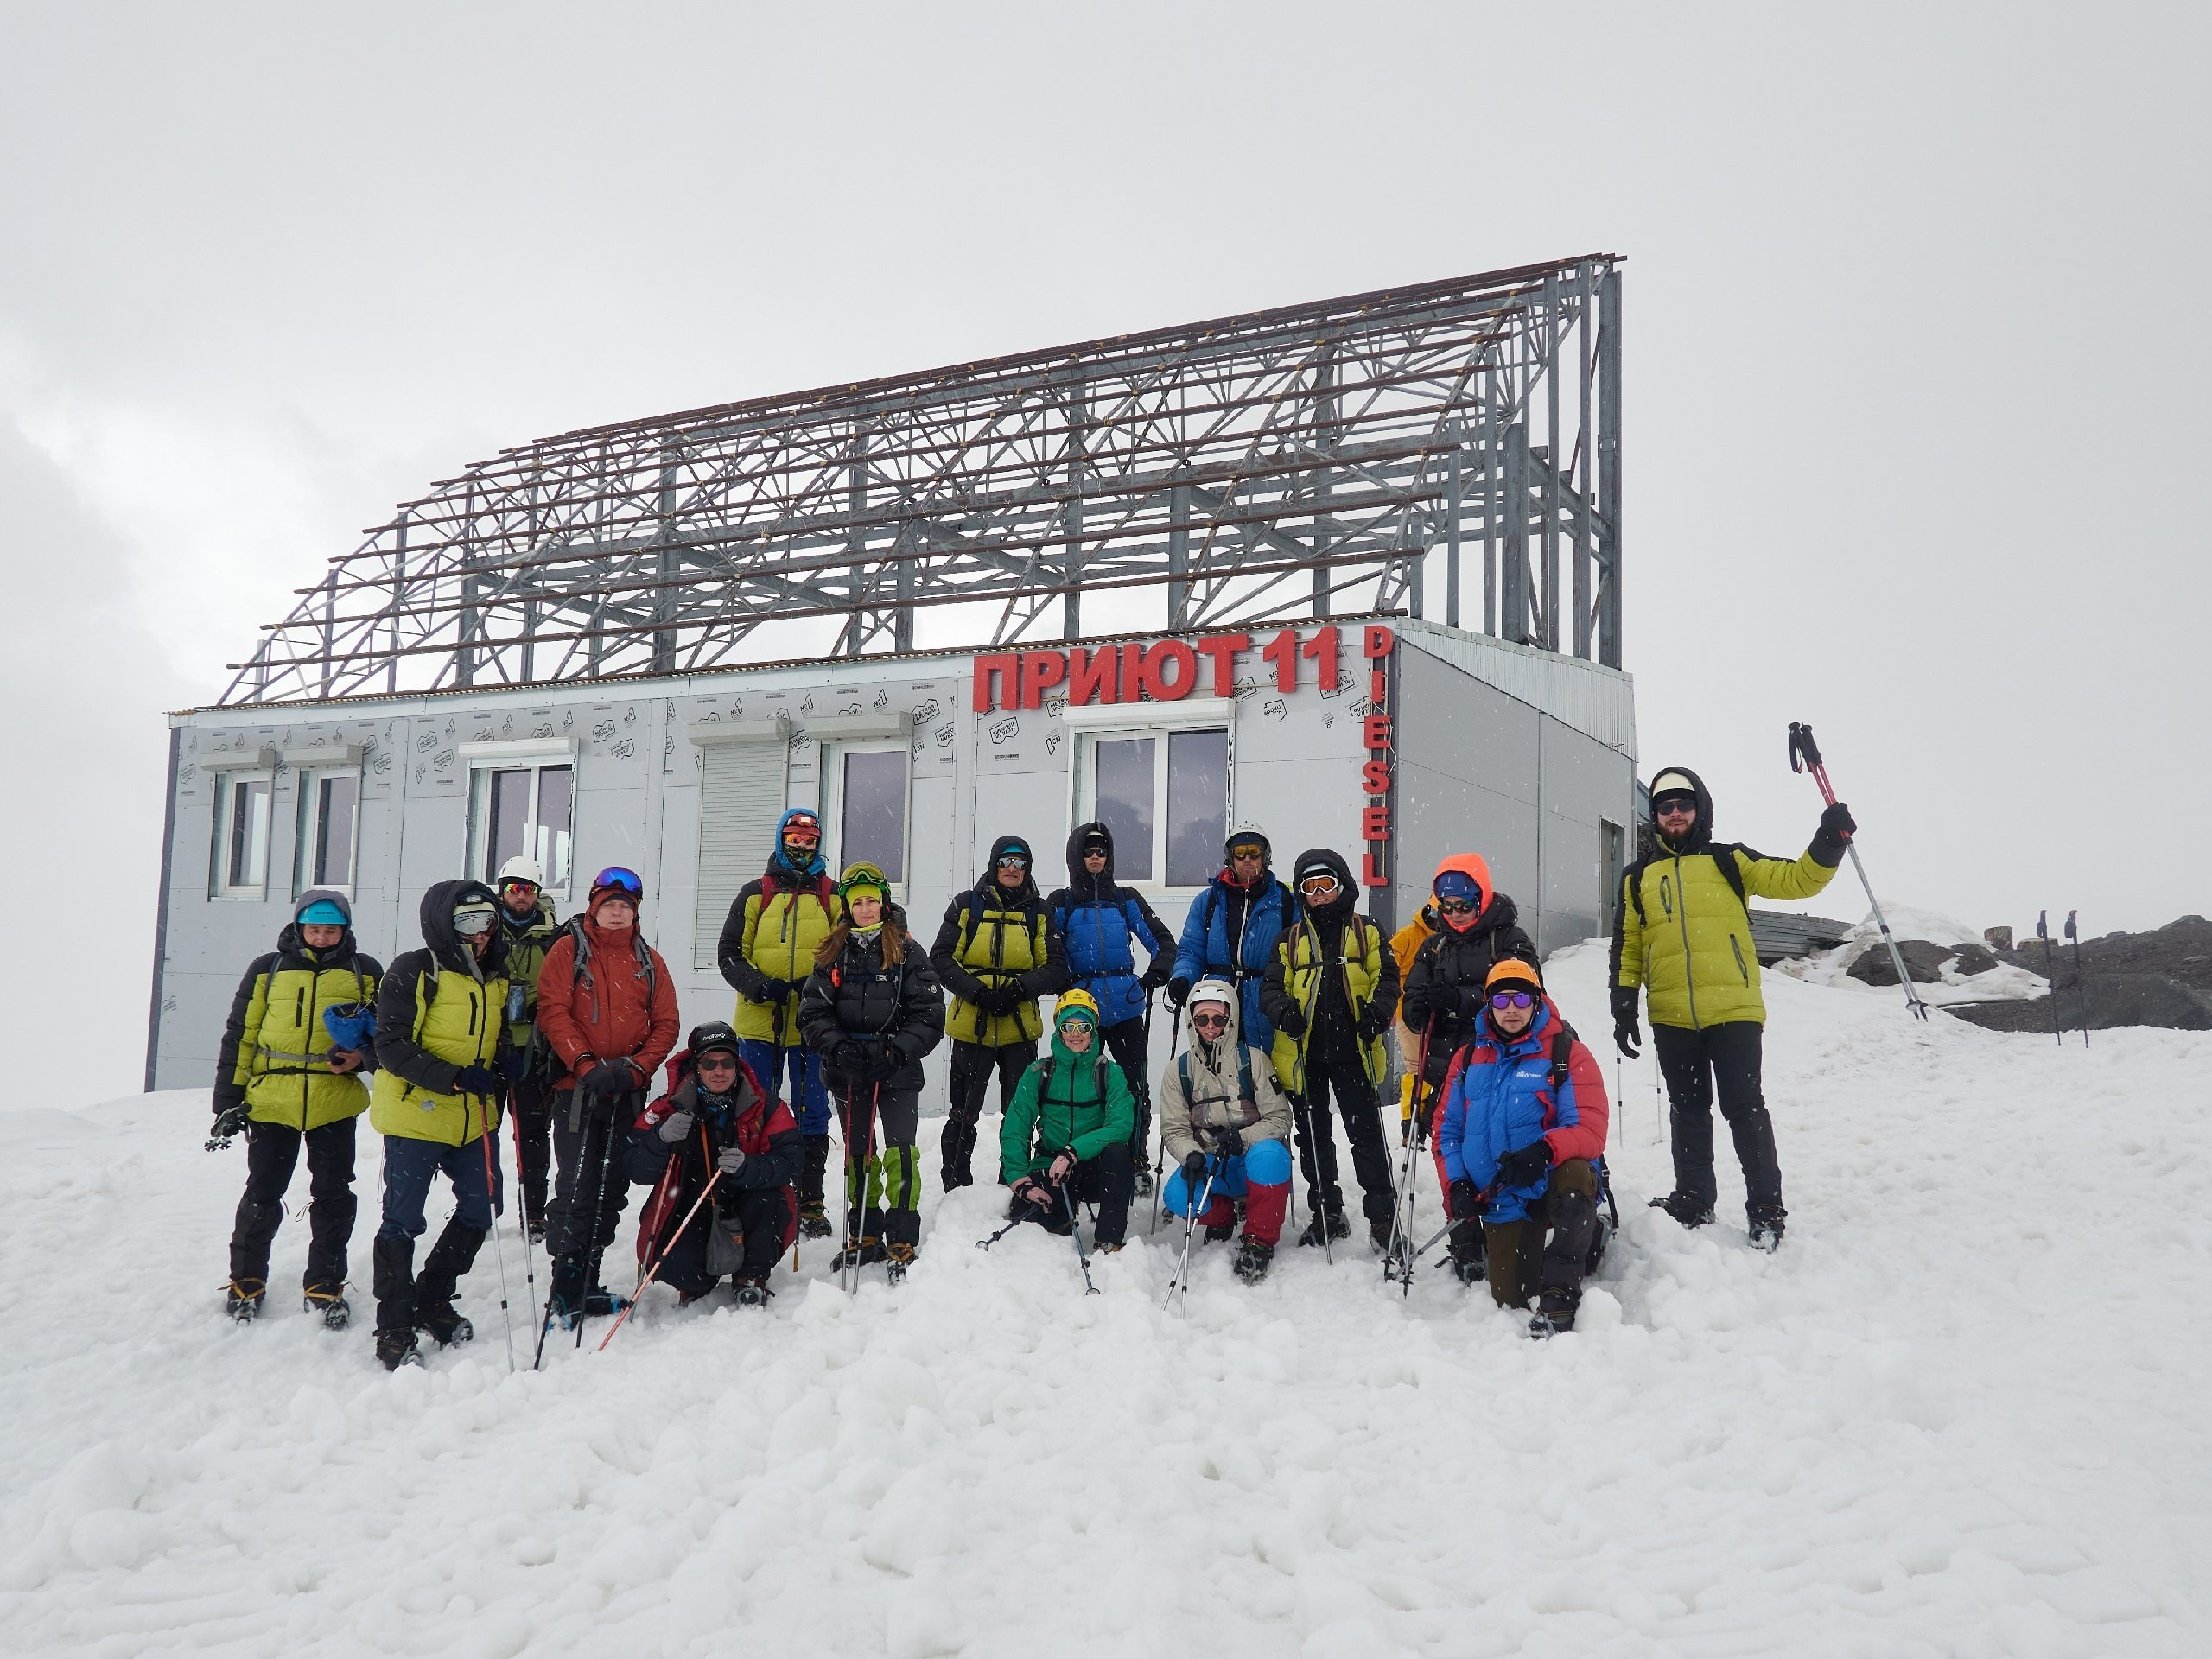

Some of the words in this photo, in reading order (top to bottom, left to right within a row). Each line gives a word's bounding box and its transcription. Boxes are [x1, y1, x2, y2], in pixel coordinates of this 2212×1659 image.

[973, 633, 1249, 712] ПРИЮТ
[1262, 626, 1338, 693] 11
[1362, 625, 1394, 887] DIESEL
